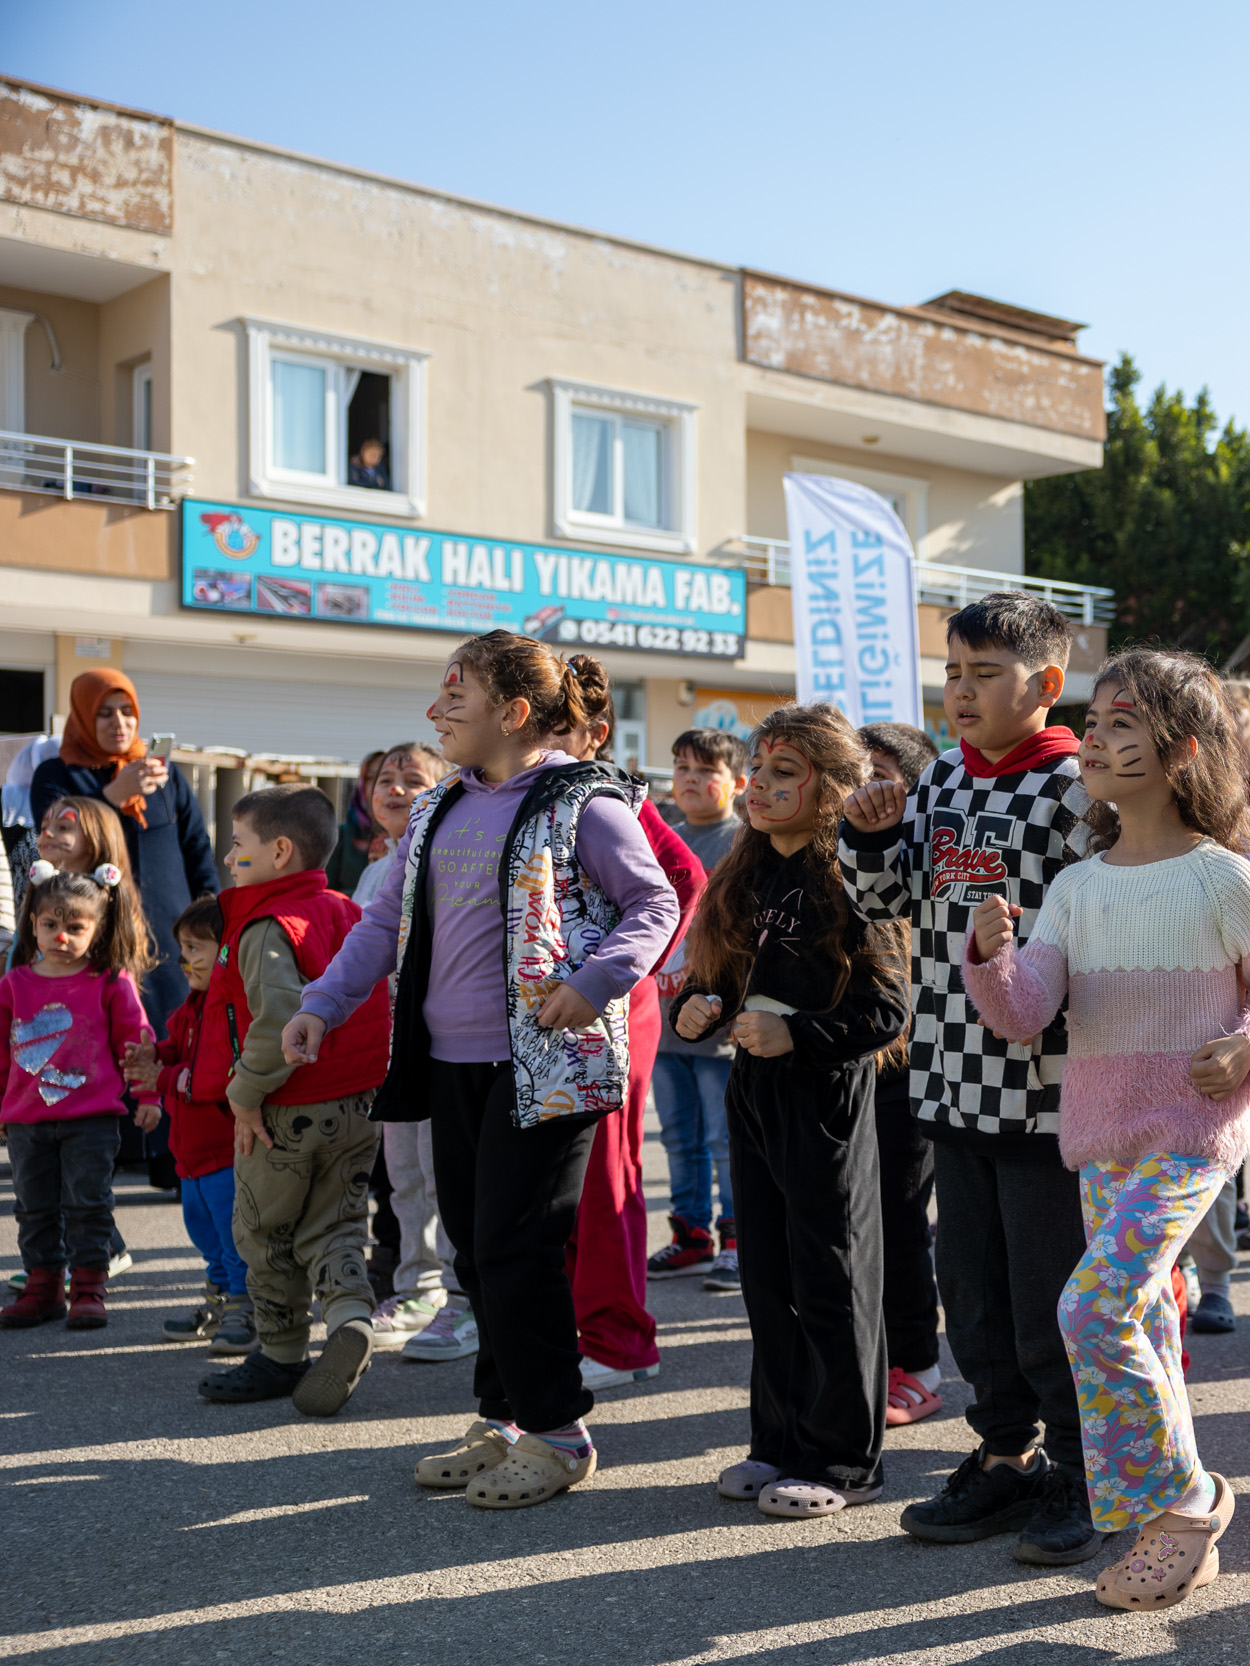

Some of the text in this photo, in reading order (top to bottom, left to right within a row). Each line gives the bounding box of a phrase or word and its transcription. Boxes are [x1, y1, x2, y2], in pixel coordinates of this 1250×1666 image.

[270, 517, 432, 583] BERRAK
[441, 539, 524, 593] HALI
[533, 551, 668, 609] YIKAMA
[673, 569, 742, 617] FAB.
[580, 619, 636, 647] 0541
[637, 624, 680, 650] 622
[682, 628, 709, 653] 92
[931, 826, 1006, 875] Brave
[438, 861, 456, 873] GO
[939, 871, 955, 882] YORK
[957, 872, 970, 881] CITY
[454, 880, 481, 889] YOUR
[966, 890, 982, 900] STAY
